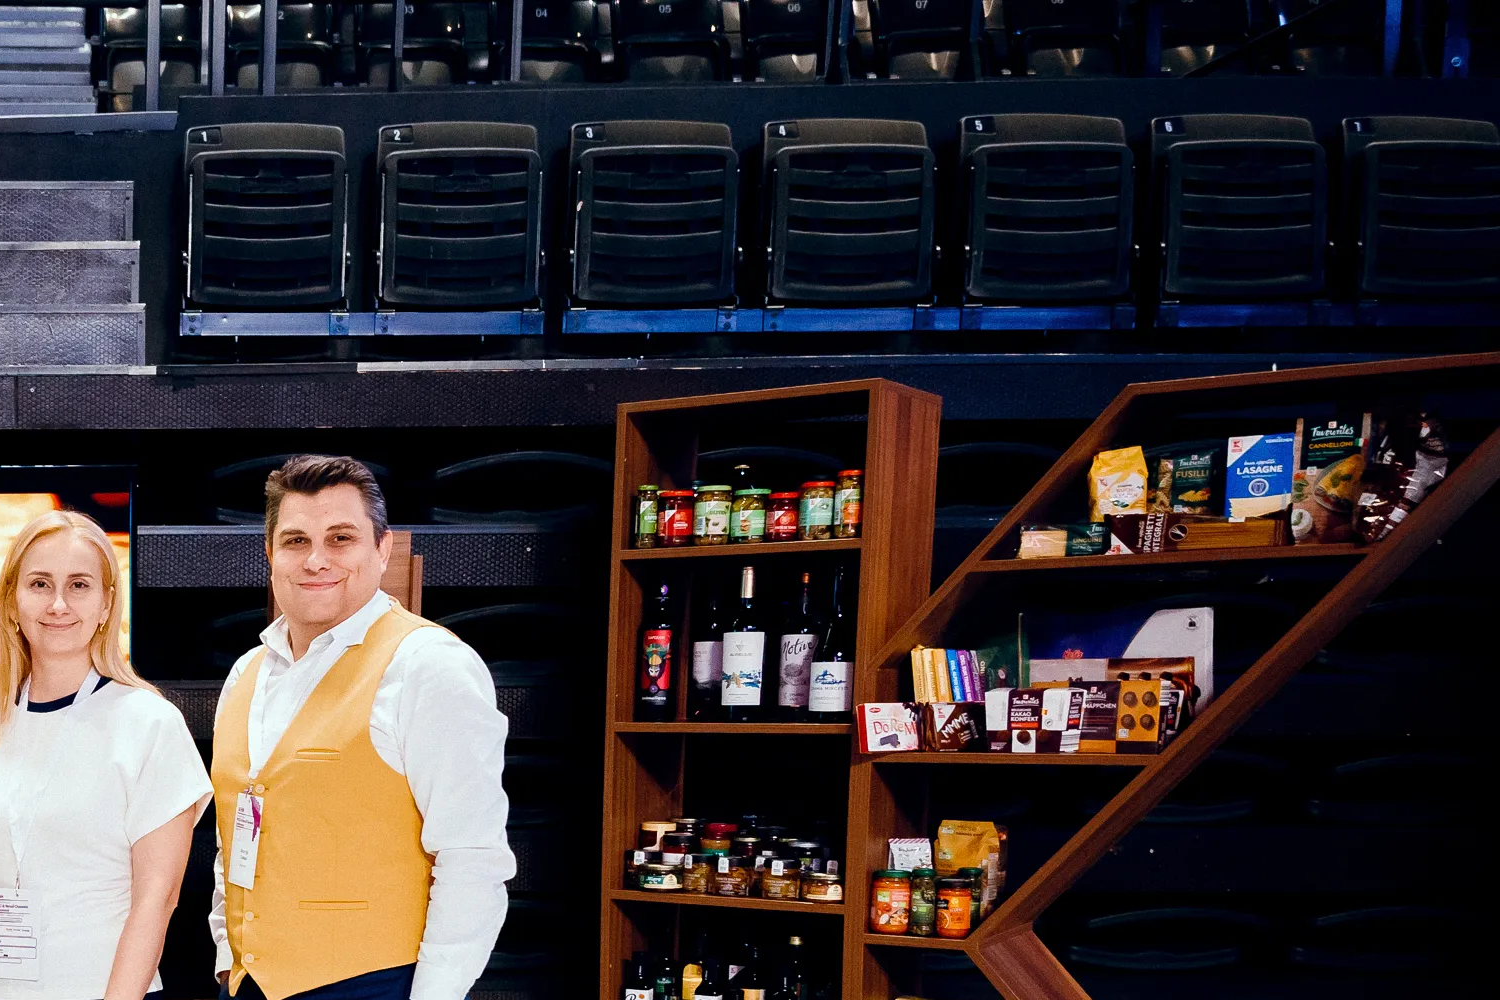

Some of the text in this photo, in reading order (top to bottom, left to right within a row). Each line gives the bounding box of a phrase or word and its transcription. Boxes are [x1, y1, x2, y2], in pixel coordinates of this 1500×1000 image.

[536, 8, 547, 17] 04
[659, 5, 671, 13] 05
[787, 4, 799, 12] 06
[779, 125, 786, 136] 4
[975, 120, 982, 131] 5
[1165, 121, 1172, 132] 6
[201, 131, 207, 141] 1
[393, 131, 400, 140] 2
[586, 128, 593, 139] 3
[1175, 469, 1209, 479] FUSILLI
[1236, 464, 1284, 475] LASAGNE
[1143, 512, 1156, 553] PAGHETTI
[1152, 512, 1165, 553] NTEGRALE
[782, 638, 815, 661] Motive
